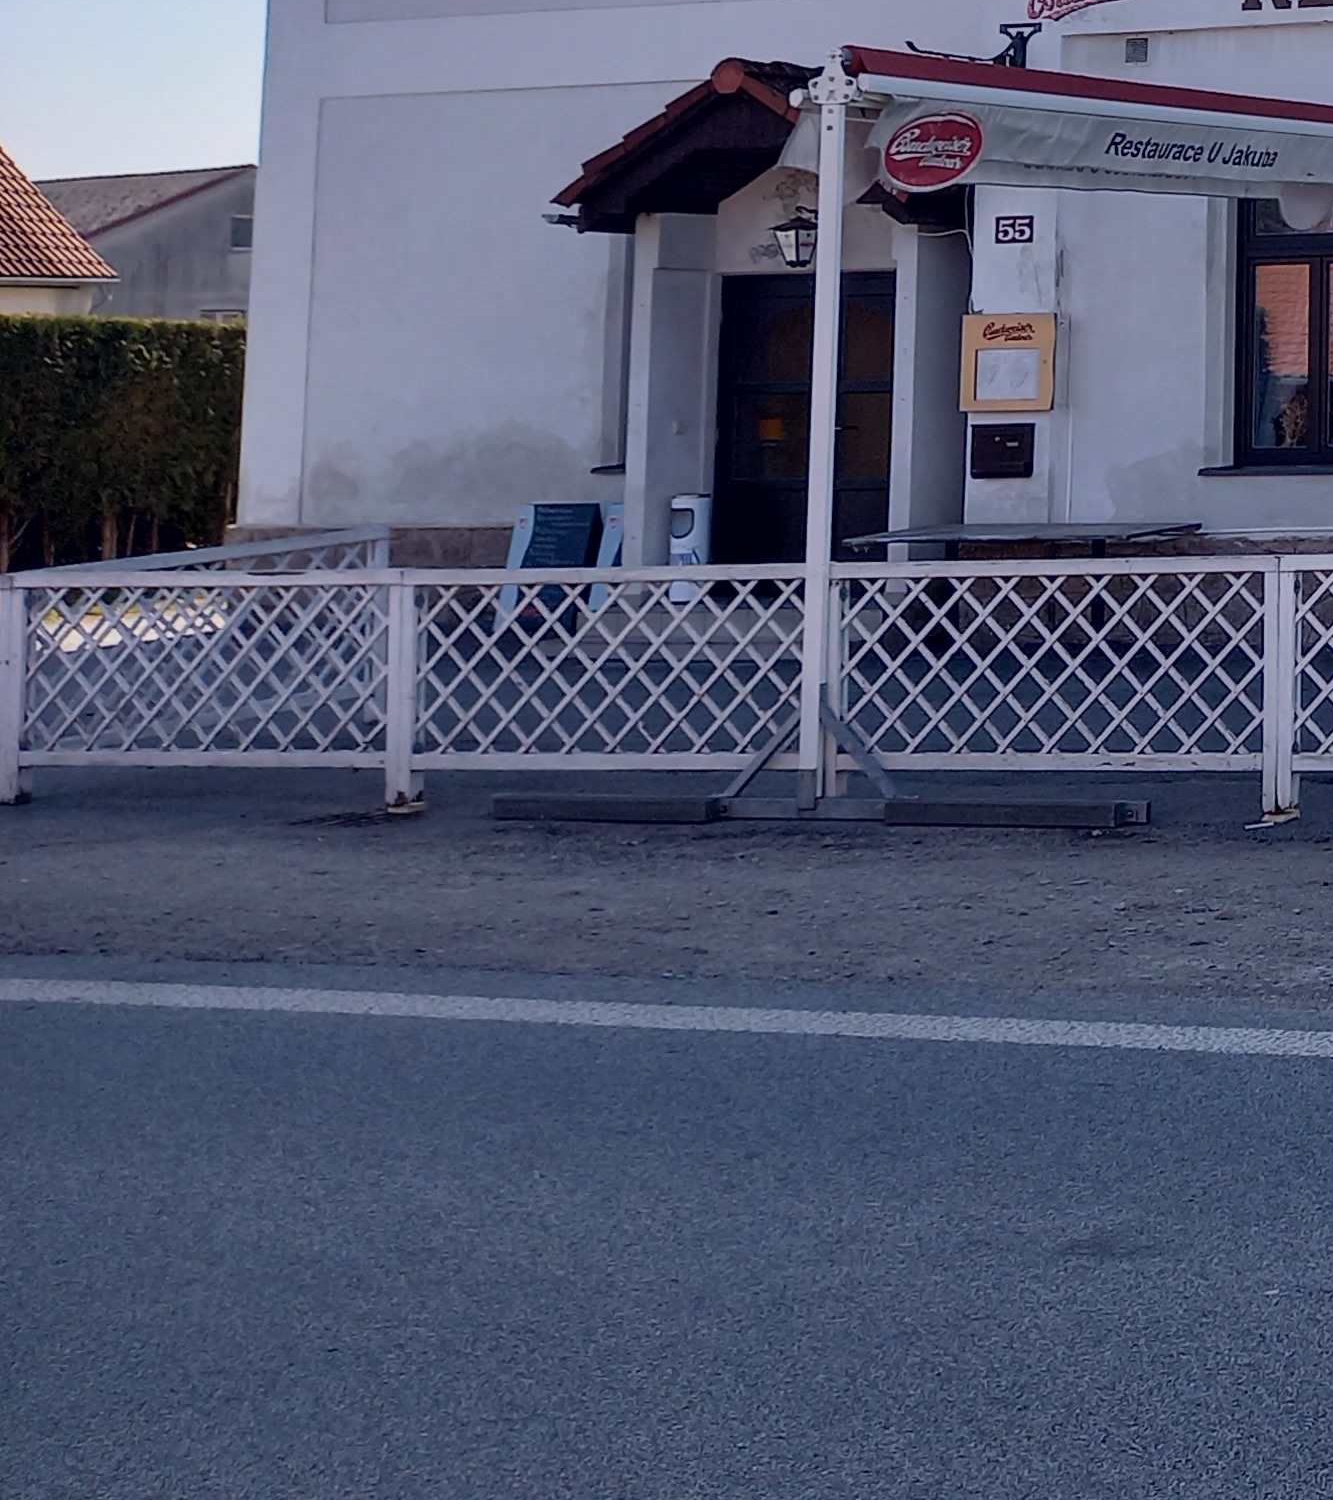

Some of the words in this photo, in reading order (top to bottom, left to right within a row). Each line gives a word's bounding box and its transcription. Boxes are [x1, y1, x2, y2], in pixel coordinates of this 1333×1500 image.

[888, 128, 972, 161] Budweiser
[1104, 132, 1204, 163] Restaurace
[1207, 141, 1225, 164] U
[1222, 142, 1279, 168] Jakuba
[997, 218, 1031, 241] 55
